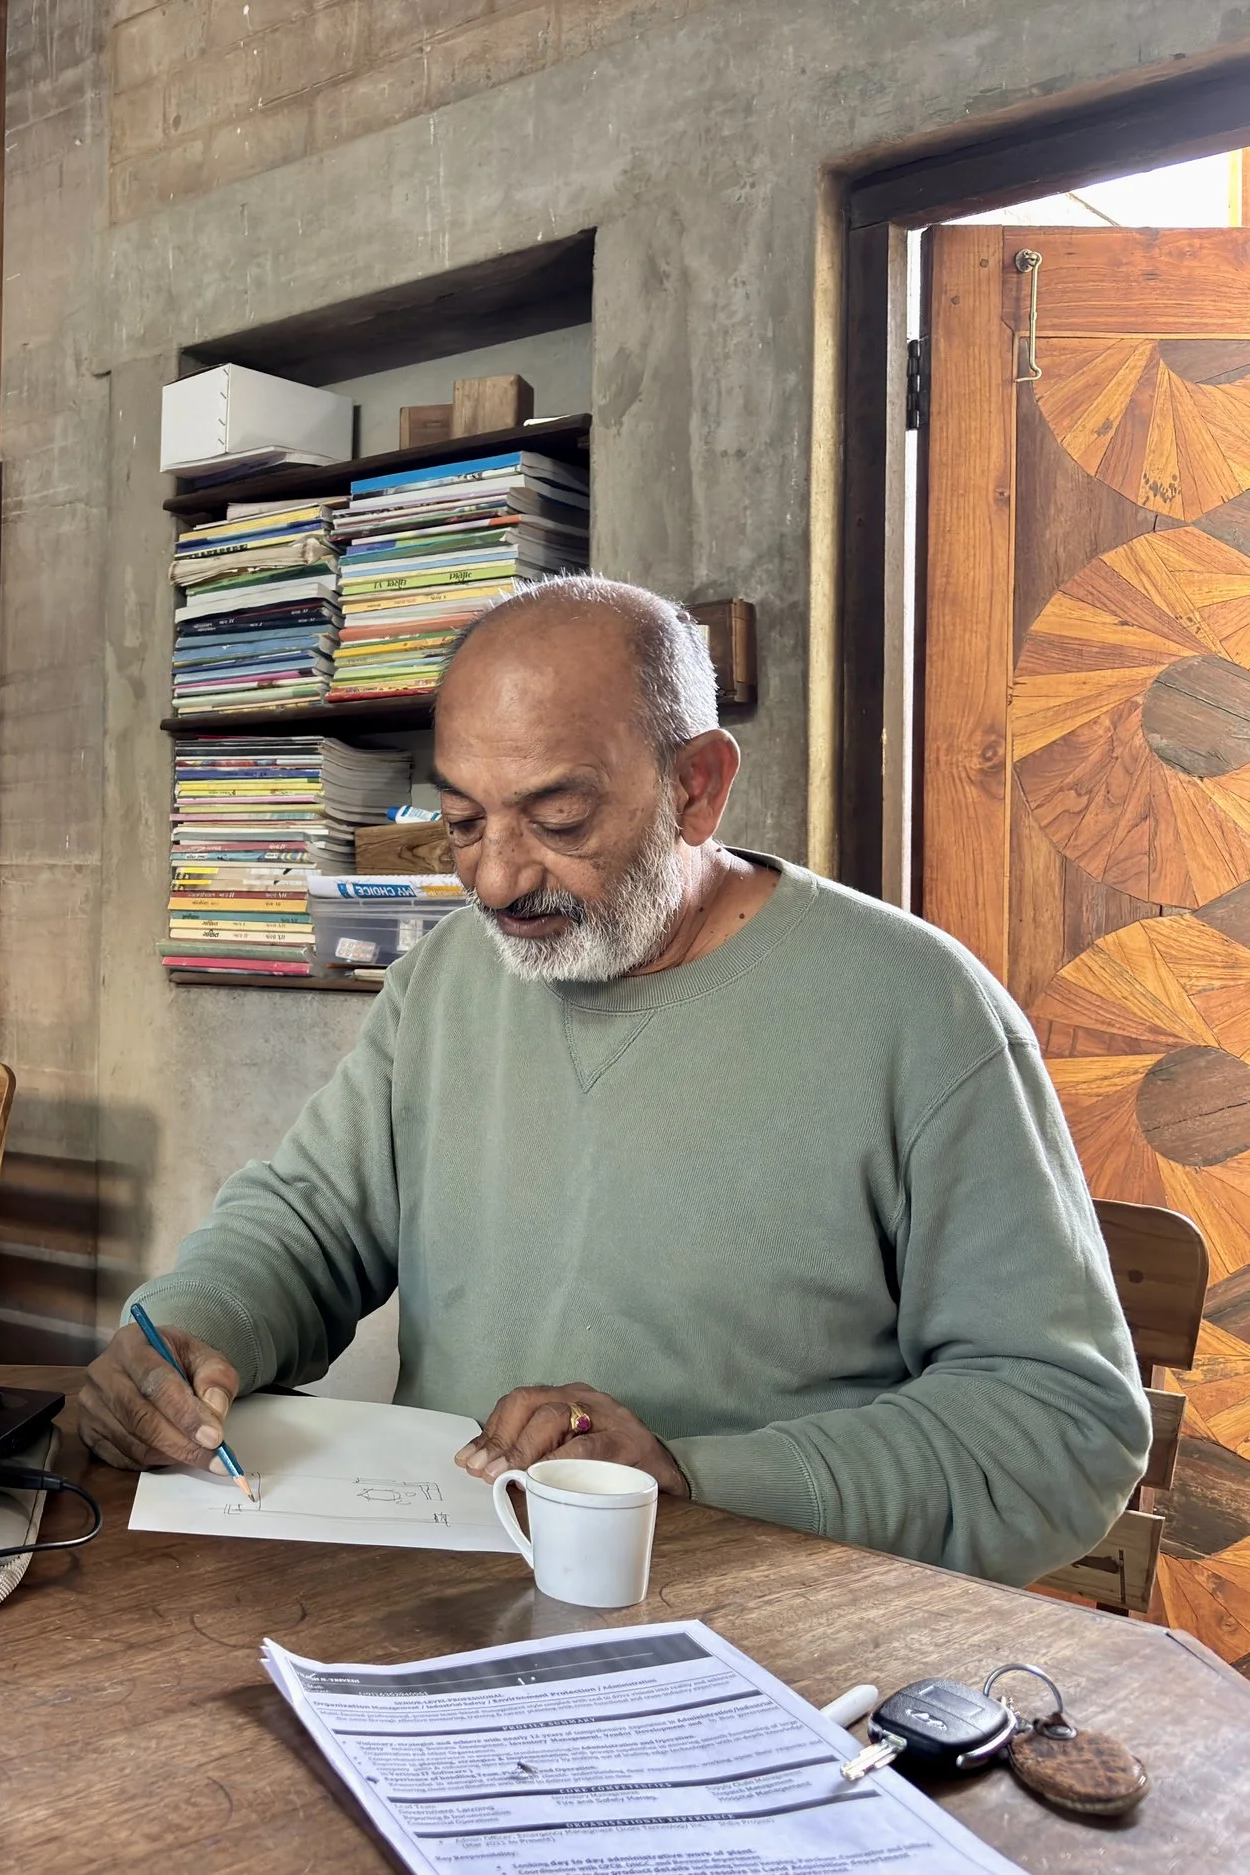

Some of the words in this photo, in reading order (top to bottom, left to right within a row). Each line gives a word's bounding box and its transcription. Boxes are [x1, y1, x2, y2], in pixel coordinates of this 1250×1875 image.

[355, 885, 395, 897] CHOICE
[398, 885, 416, 897] MY
[502, 1722, 548, 1732] PROFILE
[549, 1717, 597, 1727] SUMMARY
[591, 1781, 672, 1793] COMPETENCIES
[565, 1817, 666, 1829] ORGANISATIONAL
[667, 1813, 735, 1824] EXPERIENCE
